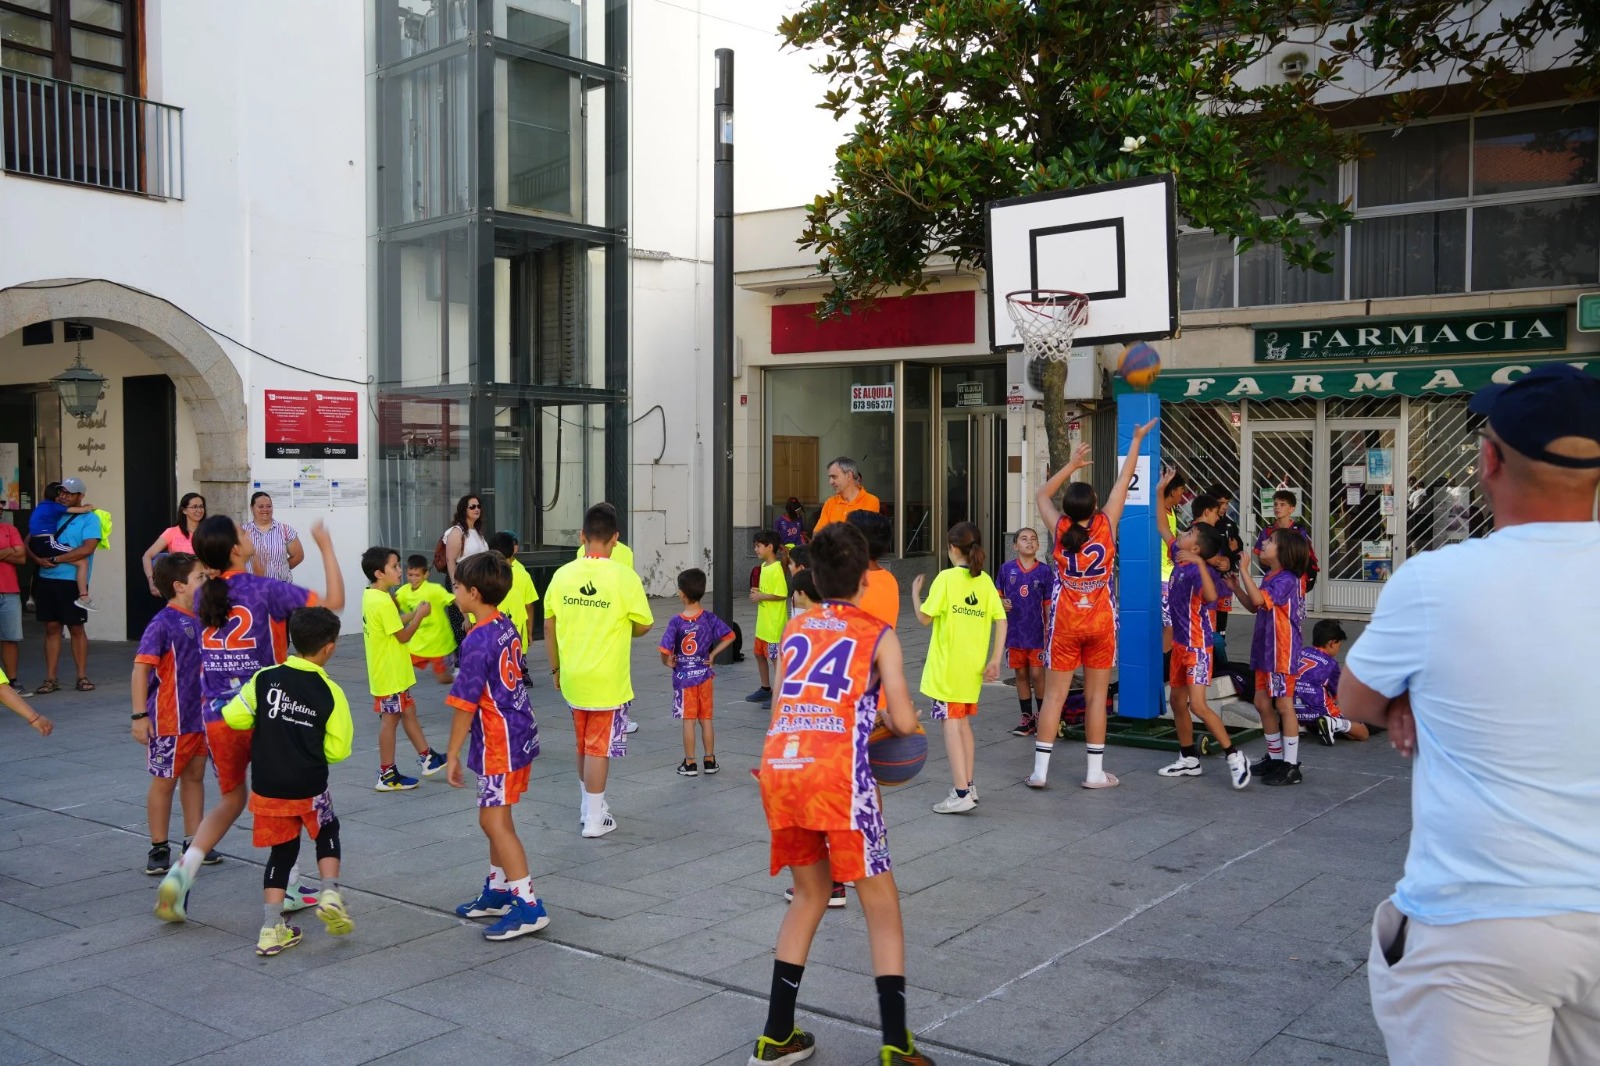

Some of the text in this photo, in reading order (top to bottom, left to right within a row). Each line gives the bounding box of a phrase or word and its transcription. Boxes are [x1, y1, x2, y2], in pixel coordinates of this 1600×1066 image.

[1300, 318, 1554, 349] FARMACIA
[1360, 346, 1401, 356] Miranda
[1183, 362, 1589, 397] FARMAC
[853, 386, 893, 400] SE ALQUILA
[853, 400, 893, 410] 673 965 377
[1127, 473, 1140, 491] 2
[1062, 543, 1107, 578] 12
[1020, 584, 1029, 597] 6
[563, 595, 611, 609] Santander
[202, 605, 257, 651] 22
[498, 627, 515, 646] CARLOS
[681, 631, 698, 656] 6
[499, 637, 523, 692] 60
[1037, 651, 1044, 661] 6
[782, 633, 858, 703] 24
[1295, 657, 1319, 680] 7
[266, 688, 282, 719] g
[281, 692, 291, 702] la
[281, 701, 318, 717] gafetina
